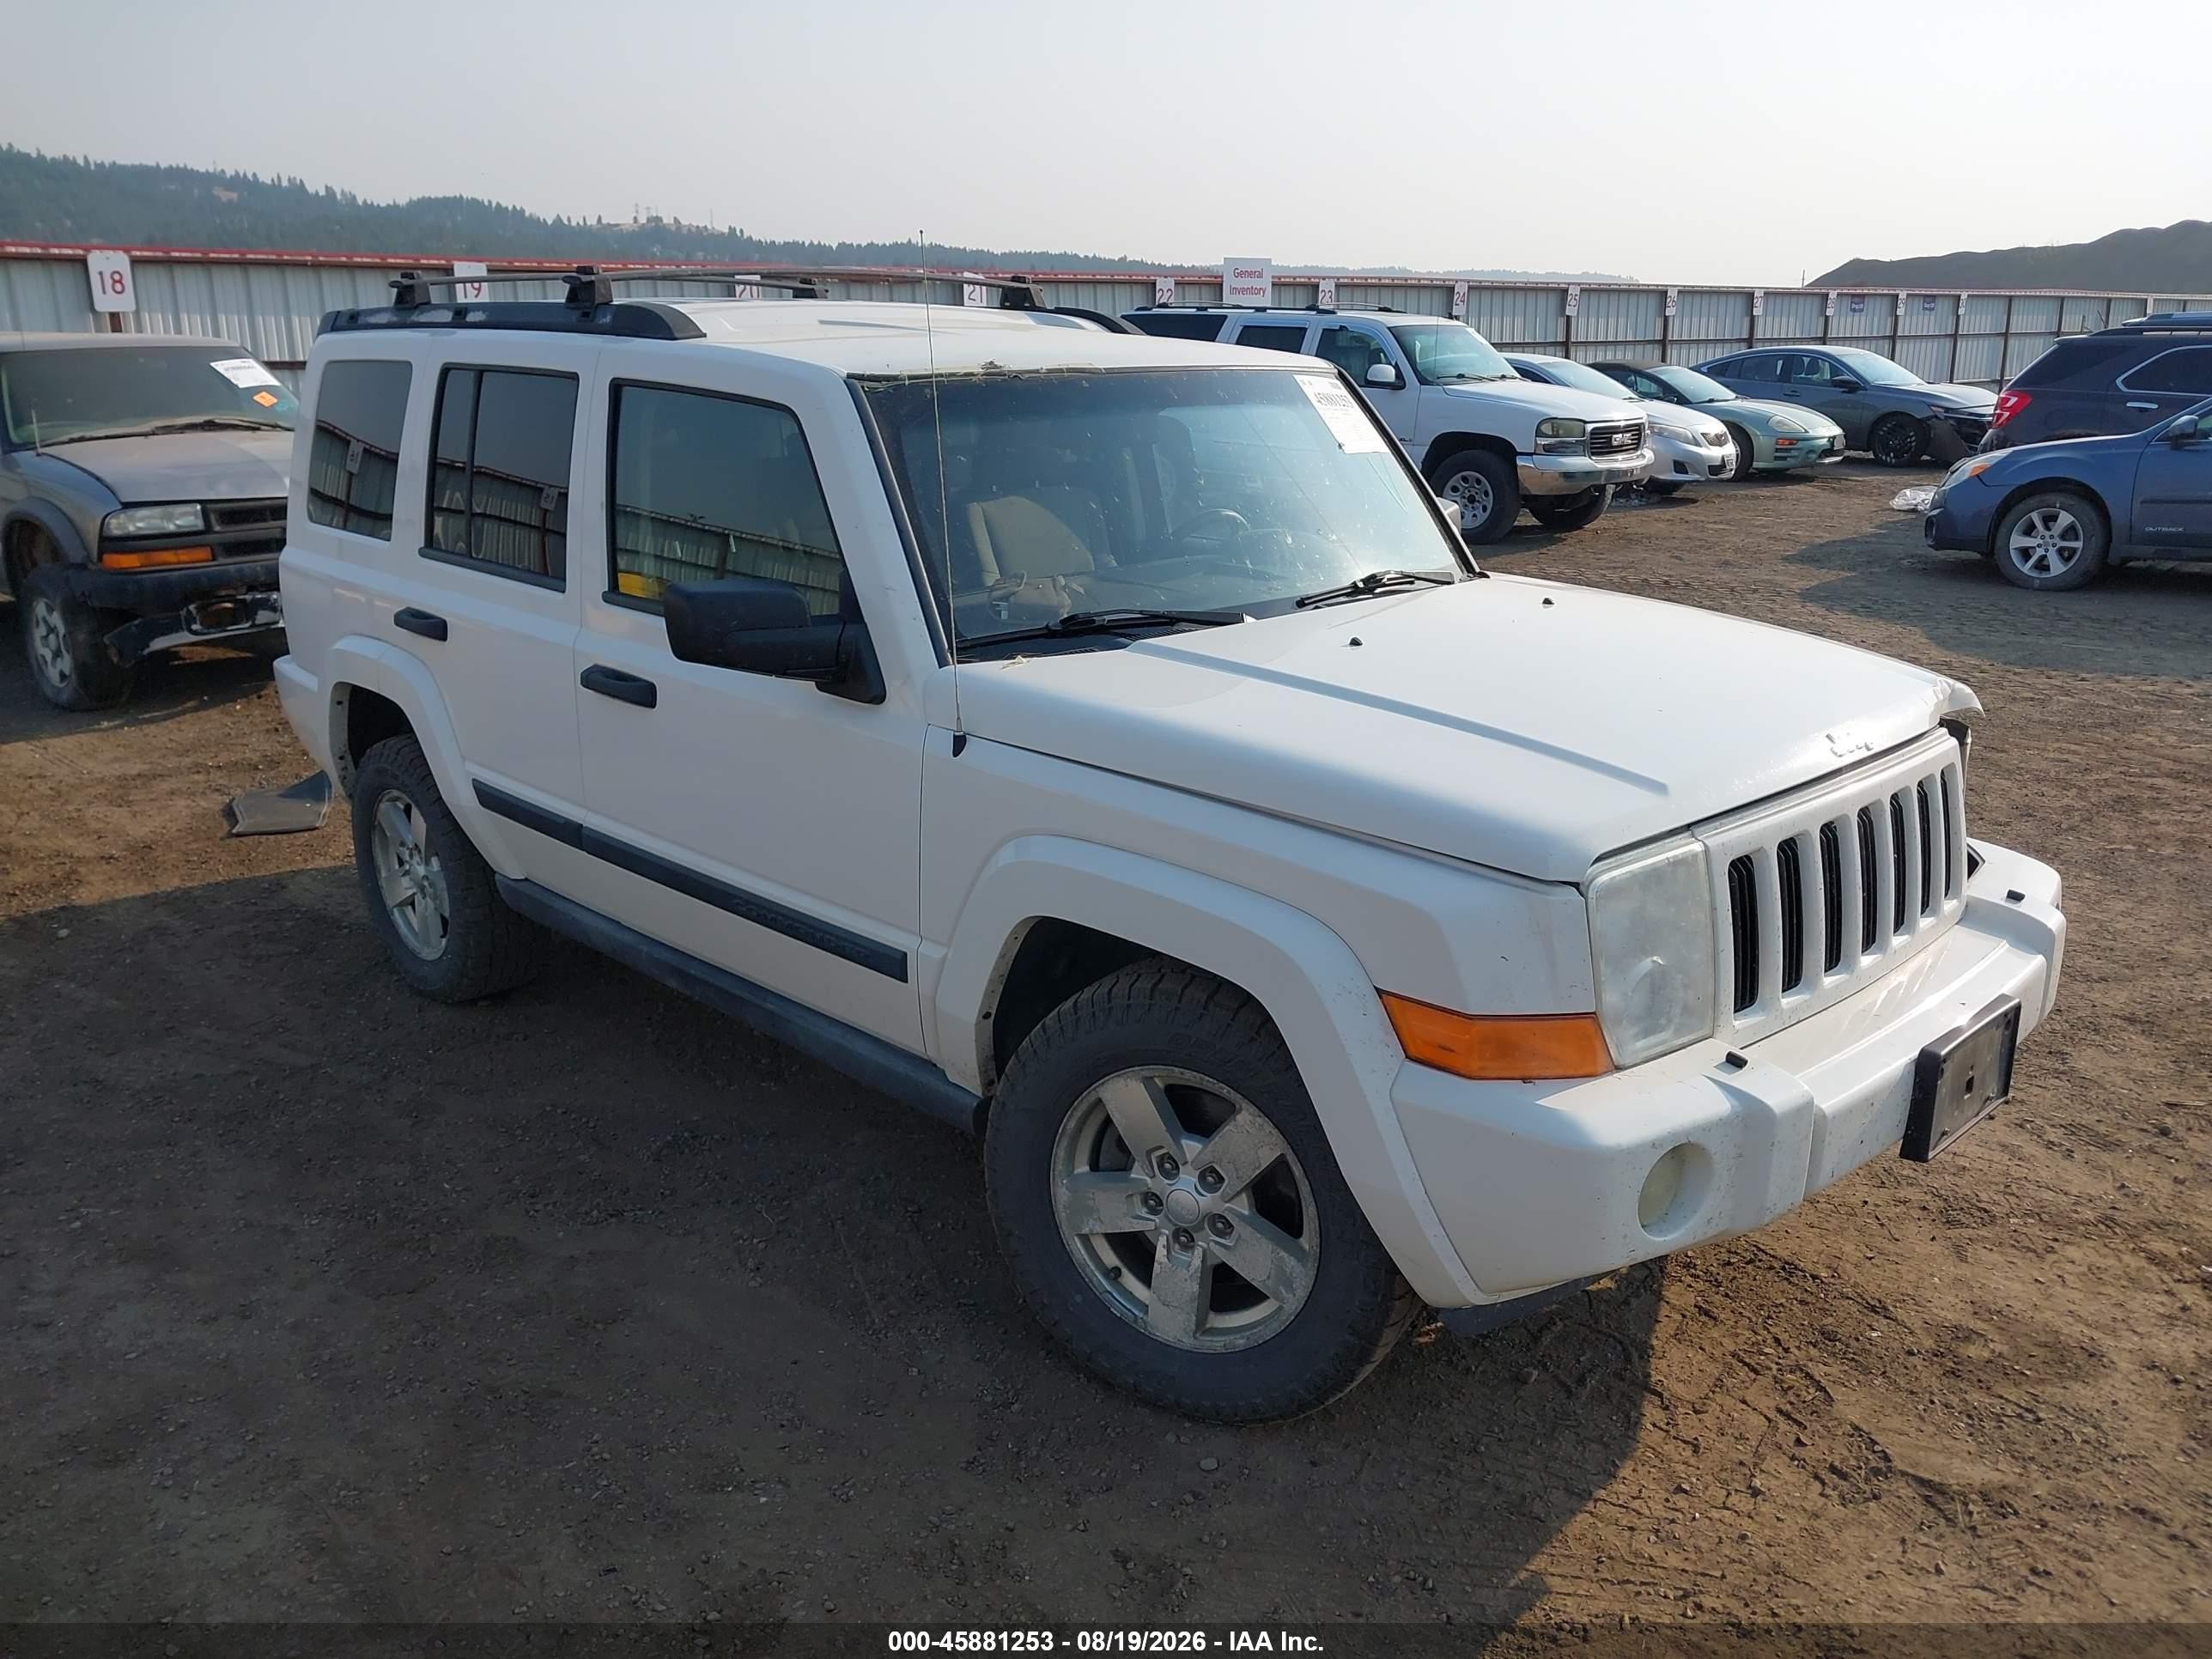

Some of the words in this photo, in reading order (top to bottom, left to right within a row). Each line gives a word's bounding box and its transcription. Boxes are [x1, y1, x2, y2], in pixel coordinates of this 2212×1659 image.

[1233, 267, 1264, 279] General
[98, 270, 125, 295] 18
[967, 283, 983, 304] 21
[1229, 284, 1267, 298] Inventory
[1320, 289, 1334, 305] 23
[1454, 290, 1466, 307] 24
[1567, 293, 1579, 307] 25
[1667, 295, 1677, 308] 26
[1753, 295, 1764, 308] 27
